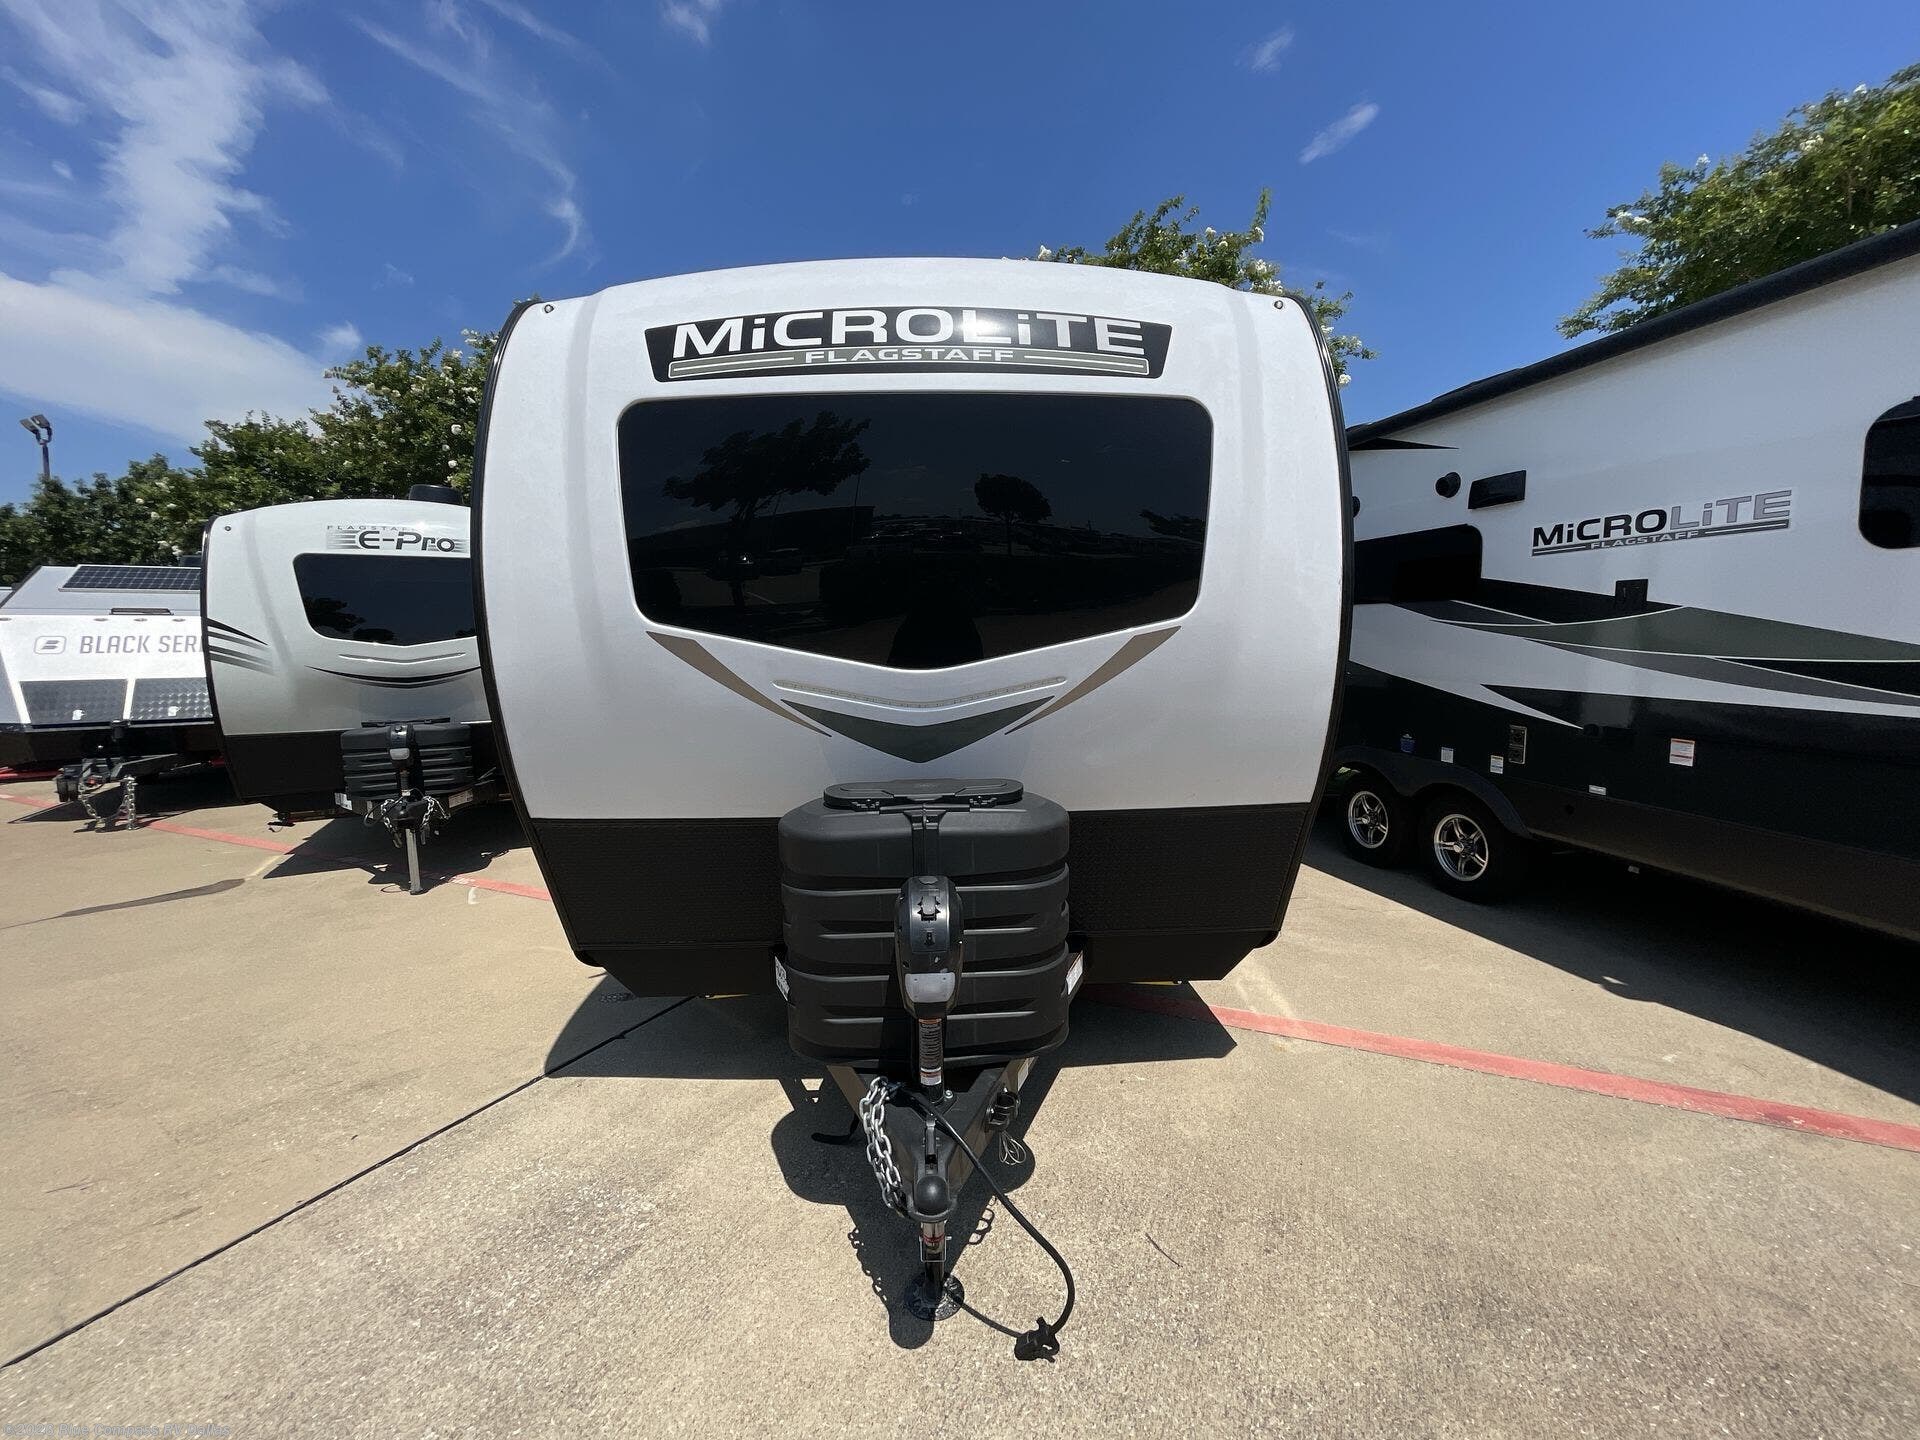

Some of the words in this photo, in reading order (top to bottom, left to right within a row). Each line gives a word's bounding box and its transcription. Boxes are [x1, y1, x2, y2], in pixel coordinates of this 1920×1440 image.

[805, 349, 1013, 364] FLAGSTAFF
[358, 531, 455, 552] E-Pro
[1590, 530, 1700, 549] FLAGSTAFF
[79, 635, 150, 654] BLACK
